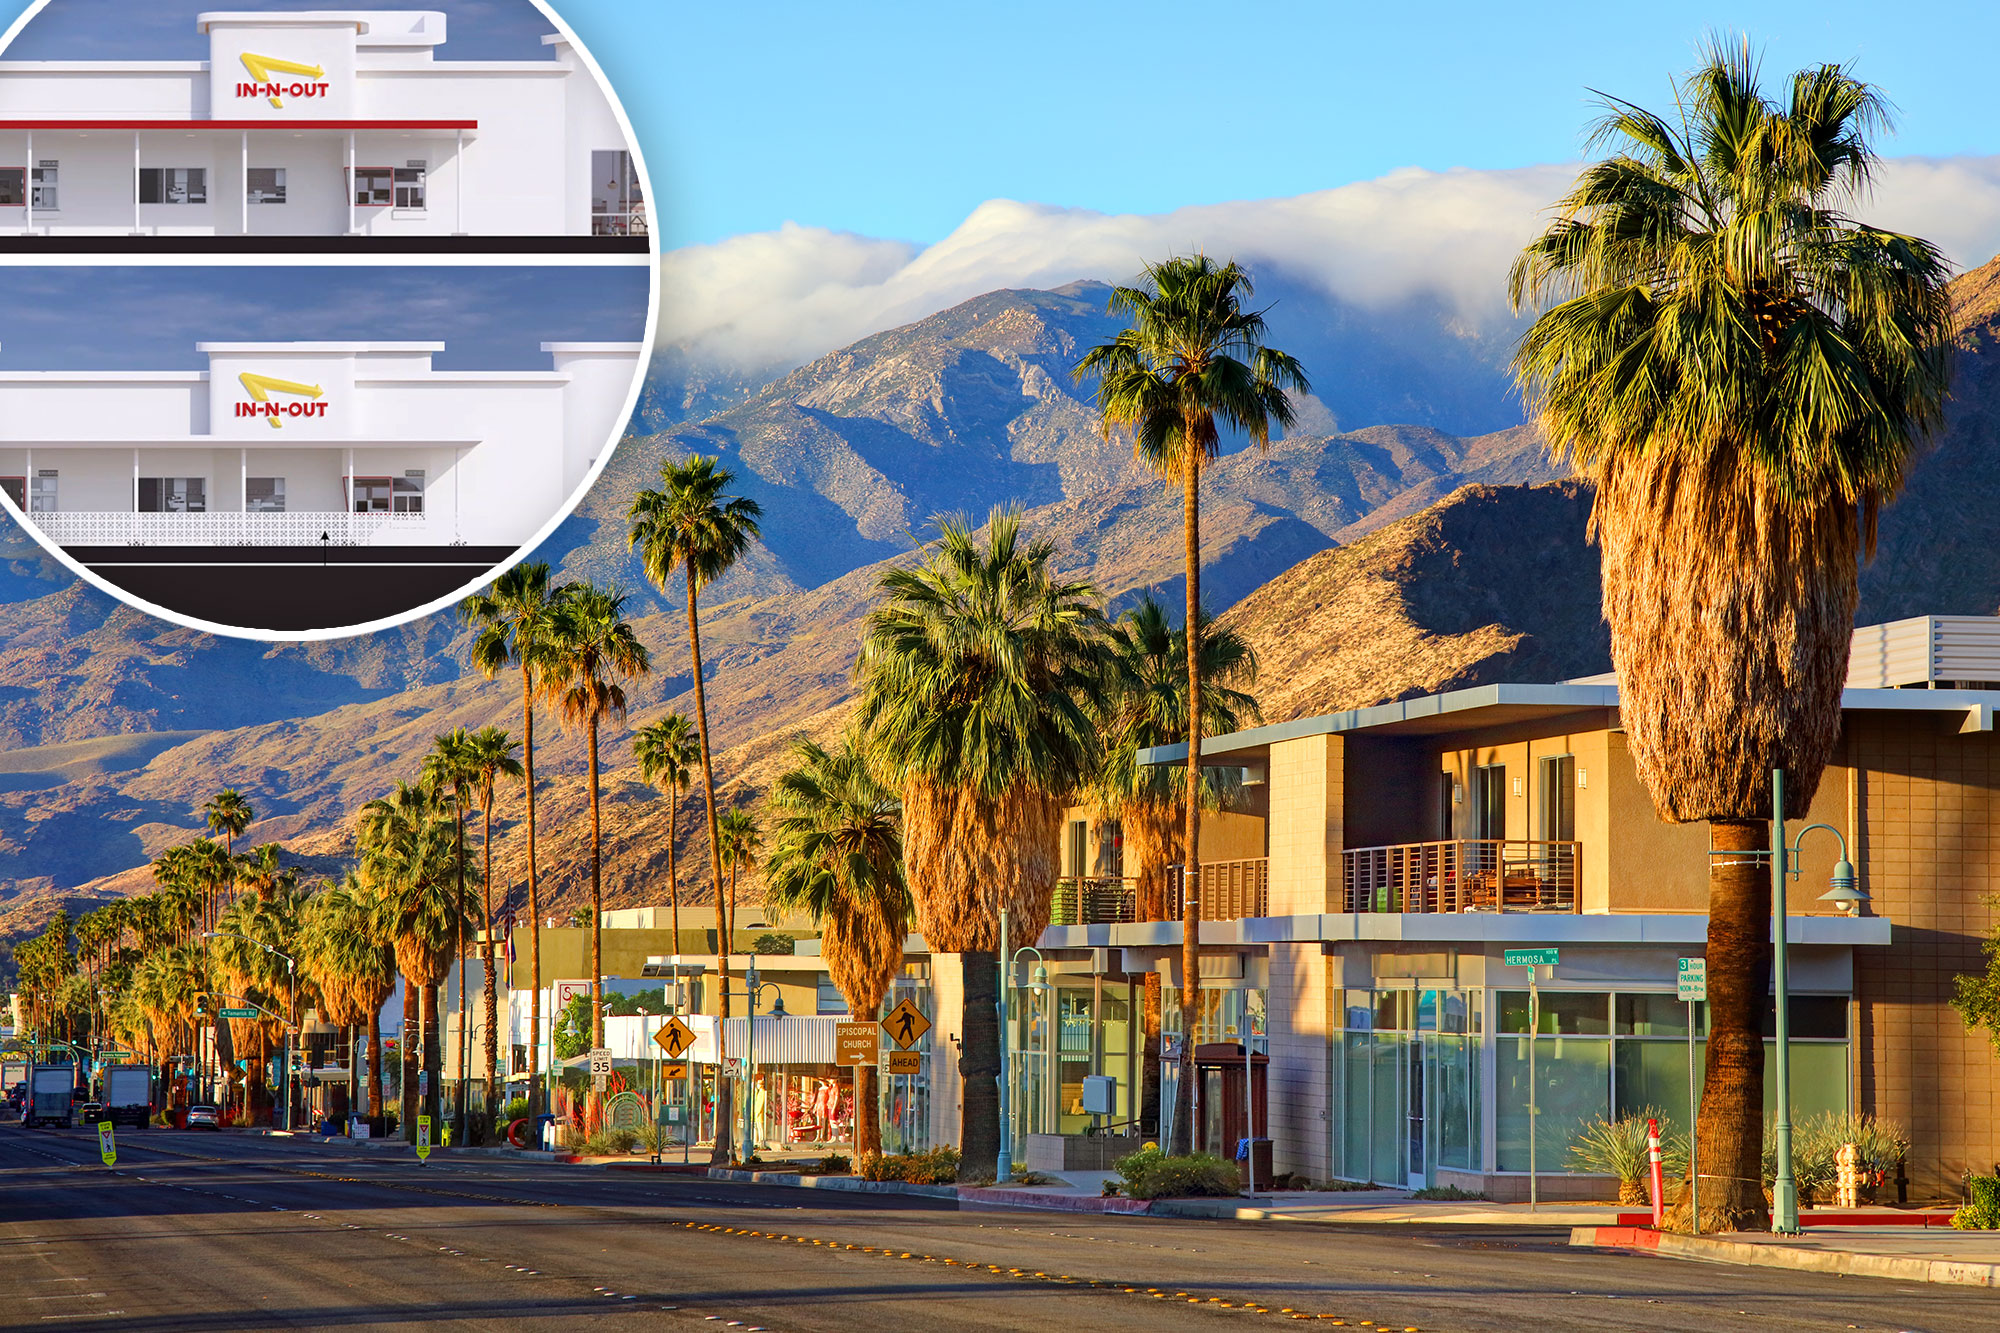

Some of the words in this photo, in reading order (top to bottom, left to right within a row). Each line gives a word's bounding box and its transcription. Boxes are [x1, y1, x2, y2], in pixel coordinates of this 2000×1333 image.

[236, 83, 329, 97] IN-N-OUT
[235, 402, 328, 417] IN-N-OUT
[1506, 955, 1545, 965] HERMOSA
[1680, 960, 1687, 970] 3
[1689, 962, 1703, 970] HOUR
[1680, 974, 1704, 983] PARKING
[837, 1027, 876, 1036] EPISCOPAL
[843, 1040, 872, 1049] CHURCH
[593, 1062, 609, 1072] 35
[892, 1058, 919, 1067] AHEAD
